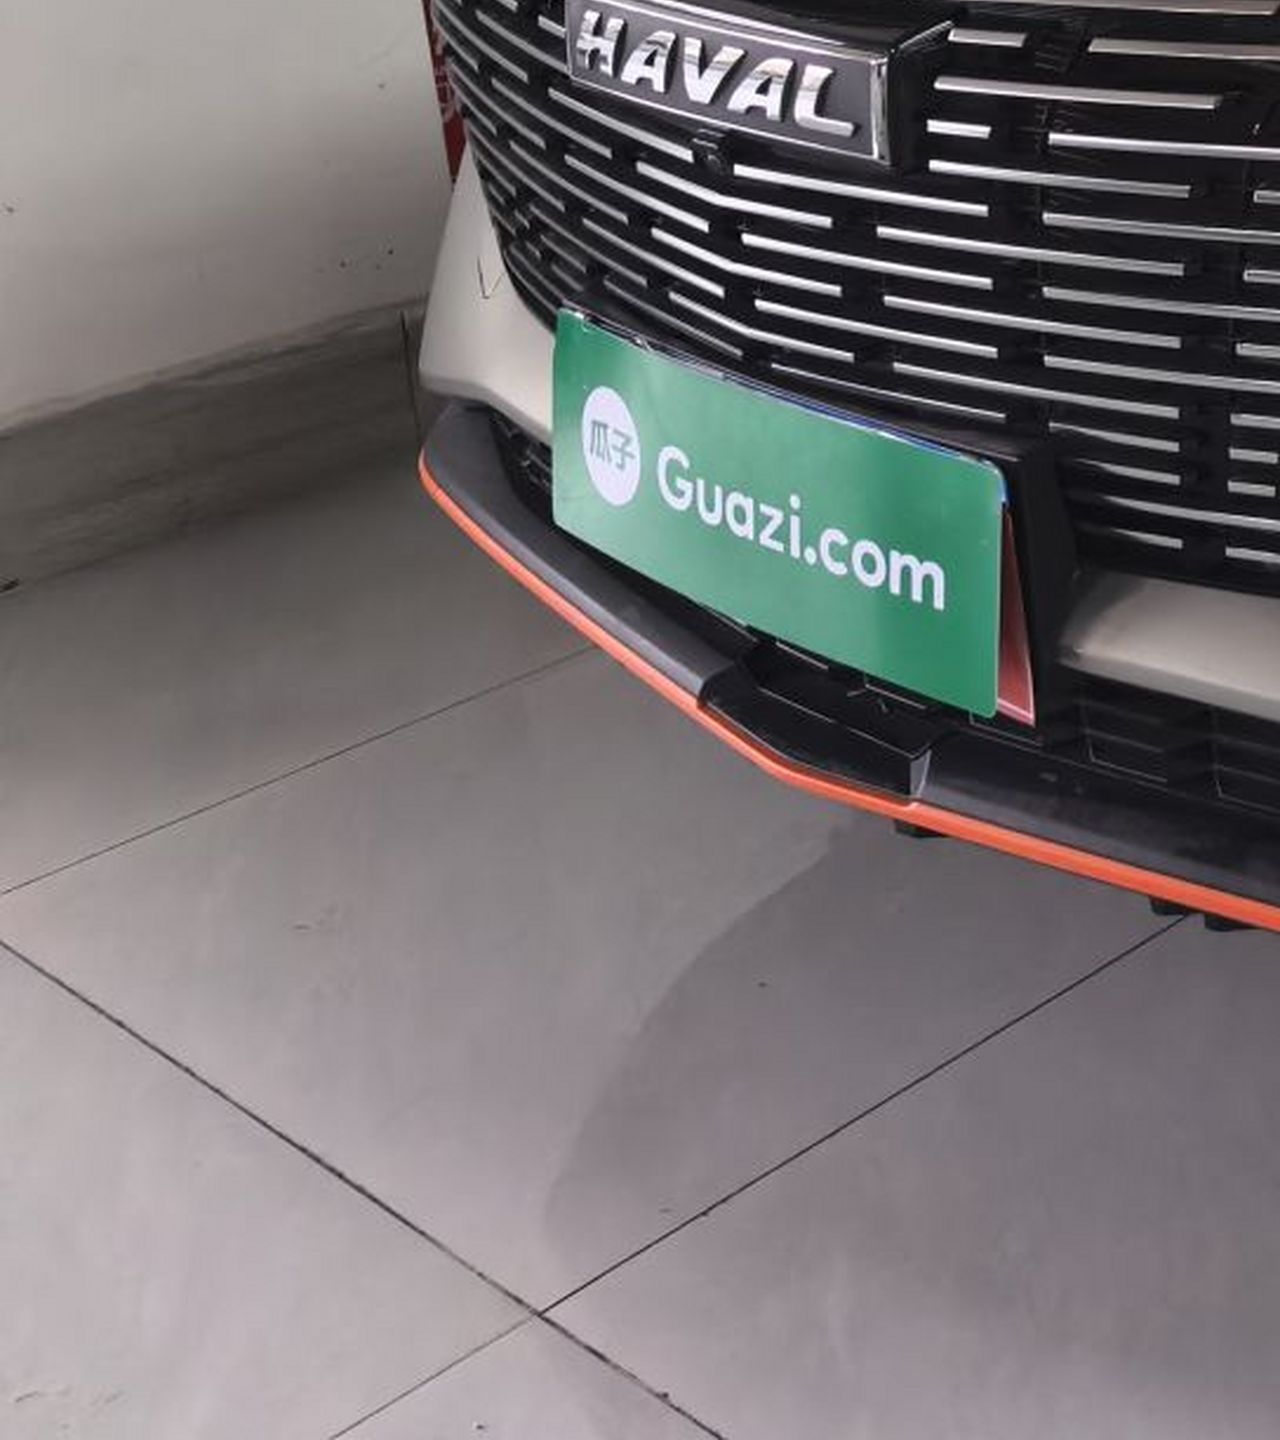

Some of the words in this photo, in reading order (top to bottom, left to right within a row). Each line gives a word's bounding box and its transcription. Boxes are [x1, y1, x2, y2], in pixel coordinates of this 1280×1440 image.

[574, 9, 856, 137] HAVAL
[589, 419, 636, 471] 瓜子
[657, 445, 945, 610] Guazi.com
